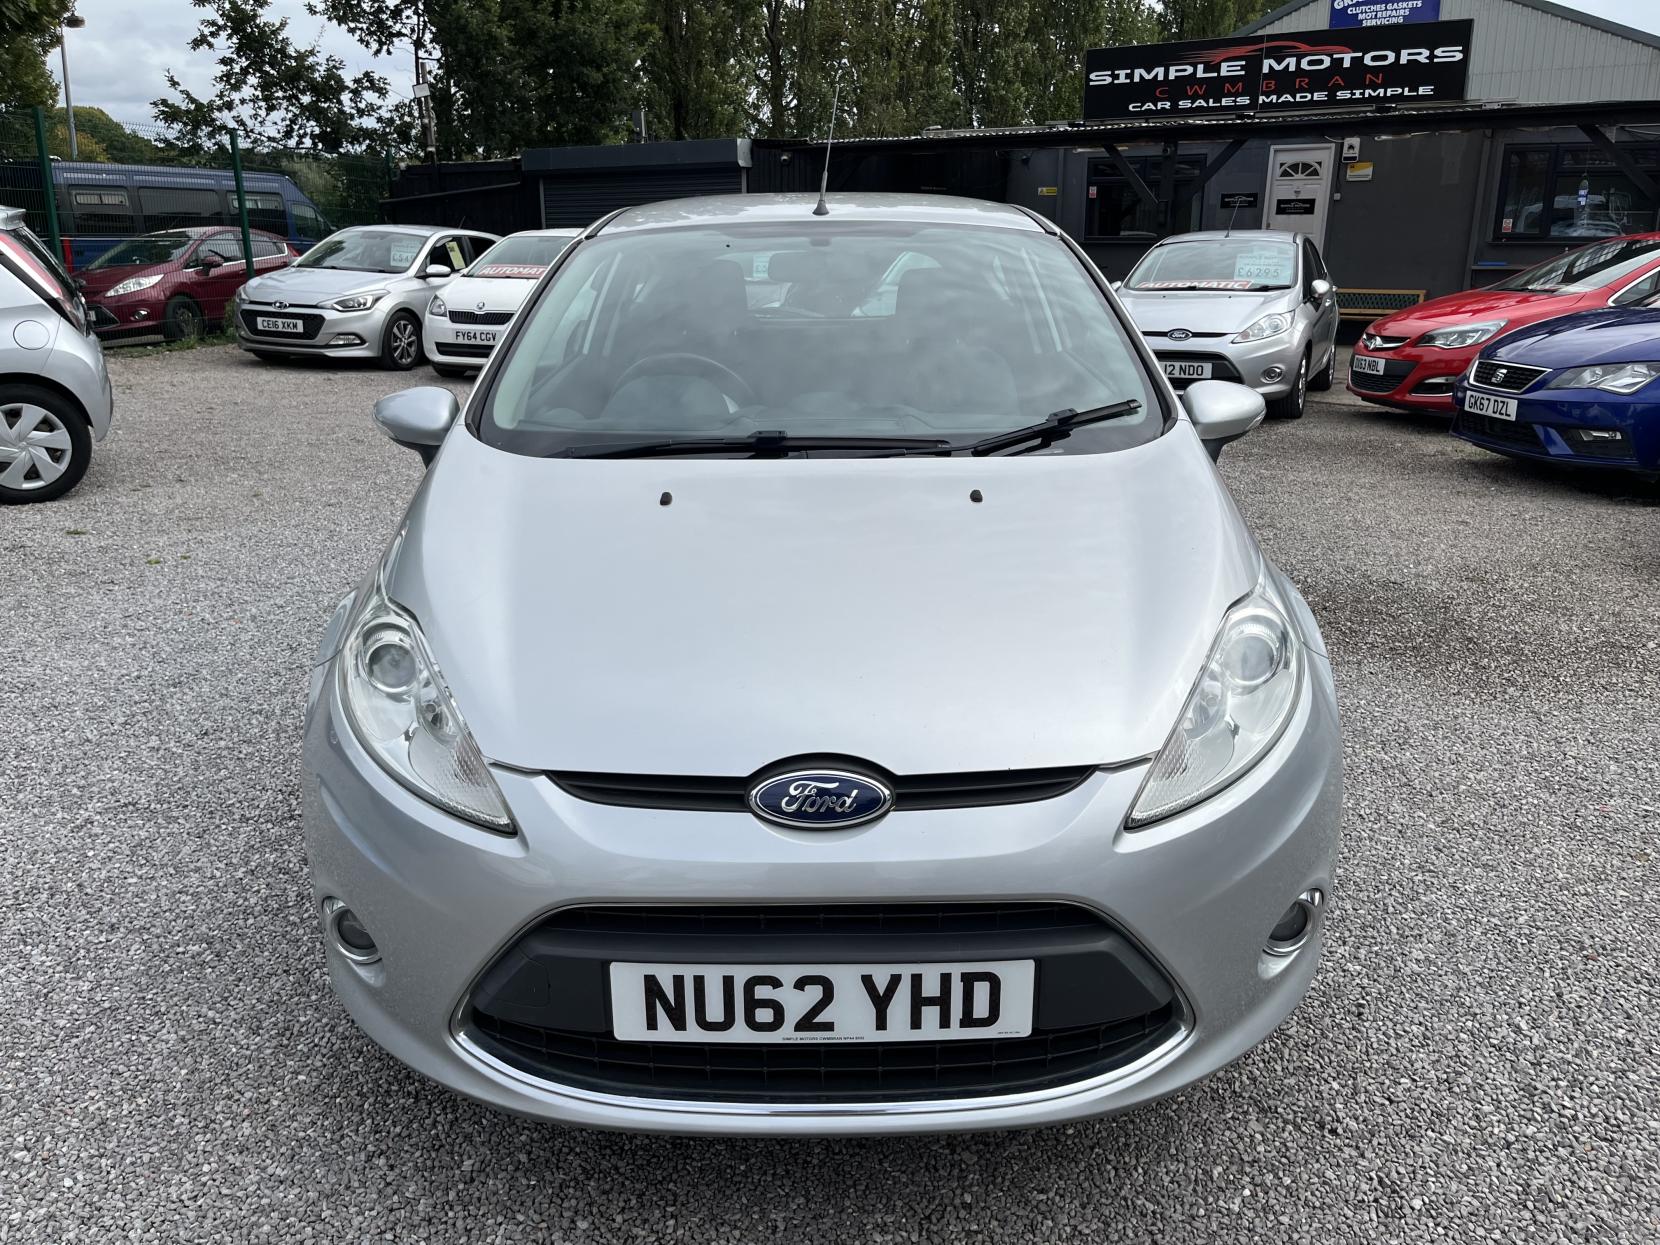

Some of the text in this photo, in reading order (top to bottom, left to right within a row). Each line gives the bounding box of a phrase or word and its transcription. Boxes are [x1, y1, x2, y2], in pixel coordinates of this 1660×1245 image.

[1347, 0, 1423, 14] CLUTCHES GASKETS
[1357, 8, 1410, 21] MOT REPAIRS
[1362, 16, 1404, 27] SERVICING
[1089, 46, 1464, 86] SIMPLE MOTORS
[1128, 86, 1435, 111] CAR SALES MADE SIMPLE
[261, 319, 298, 331] CE16 XKM
[455, 330, 497, 342] FY64 CGV
[1468, 394, 1511, 417] GK67 DZL
[781, 780, 859, 813] Ford
[642, 971, 1001, 1033] NU62 YHD
